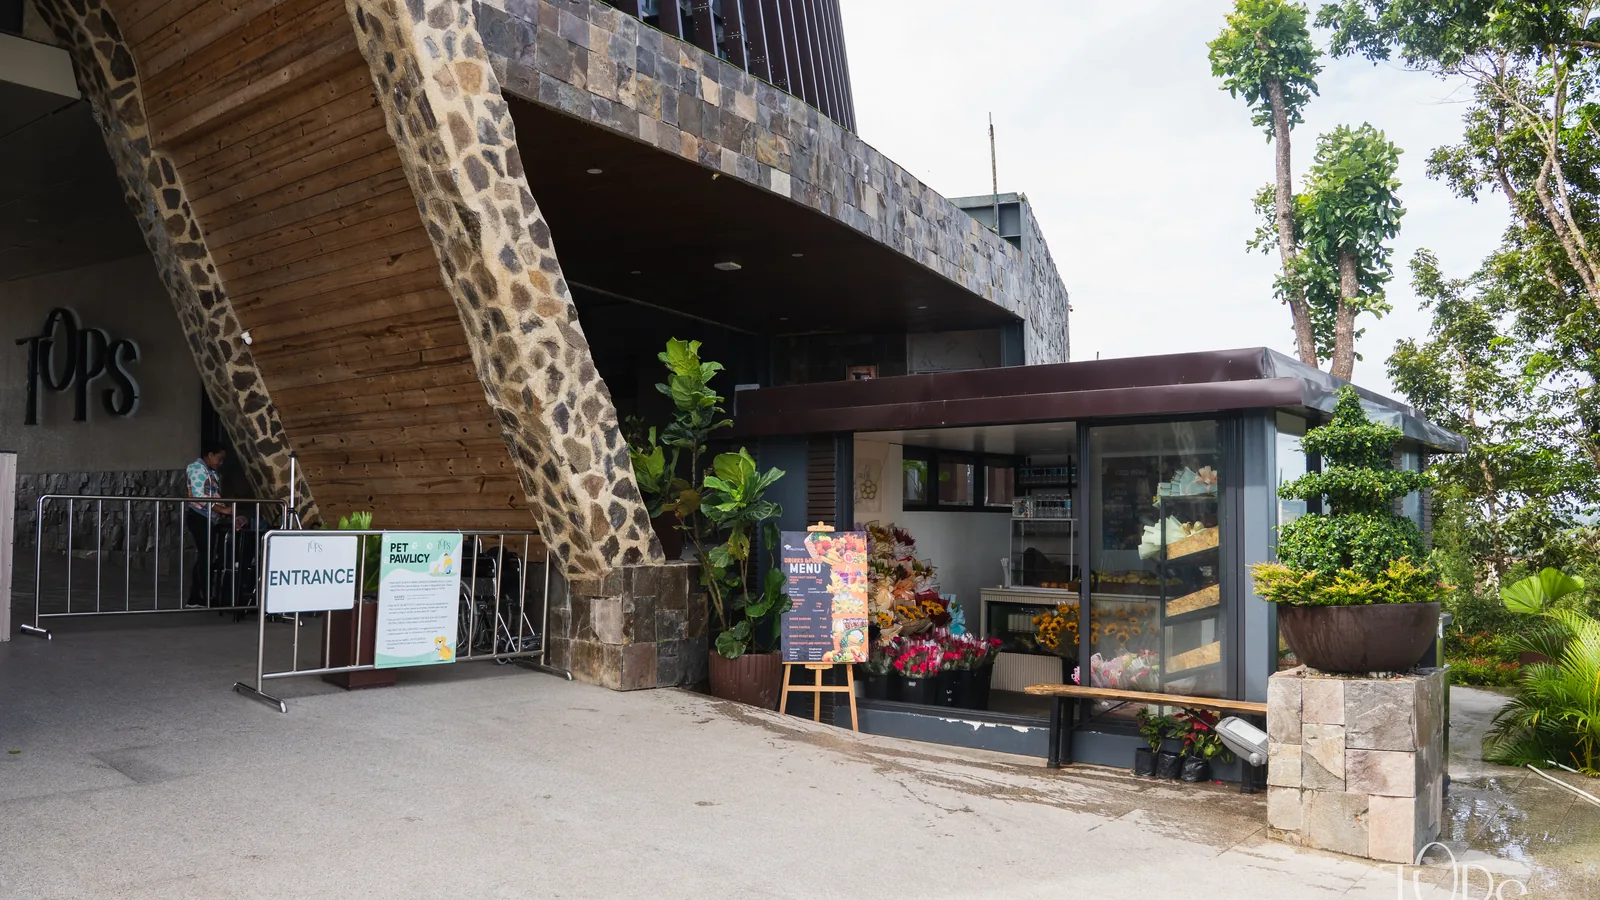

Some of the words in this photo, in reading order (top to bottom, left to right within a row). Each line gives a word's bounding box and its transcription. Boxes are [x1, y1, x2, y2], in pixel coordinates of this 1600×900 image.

[15, 307, 141, 425] TOPS
[390, 543, 409, 553] PET
[389, 553, 430, 564] PAWLICY
[789, 563, 822, 574] MENU
[269, 568, 354, 586] ENTRANCE
